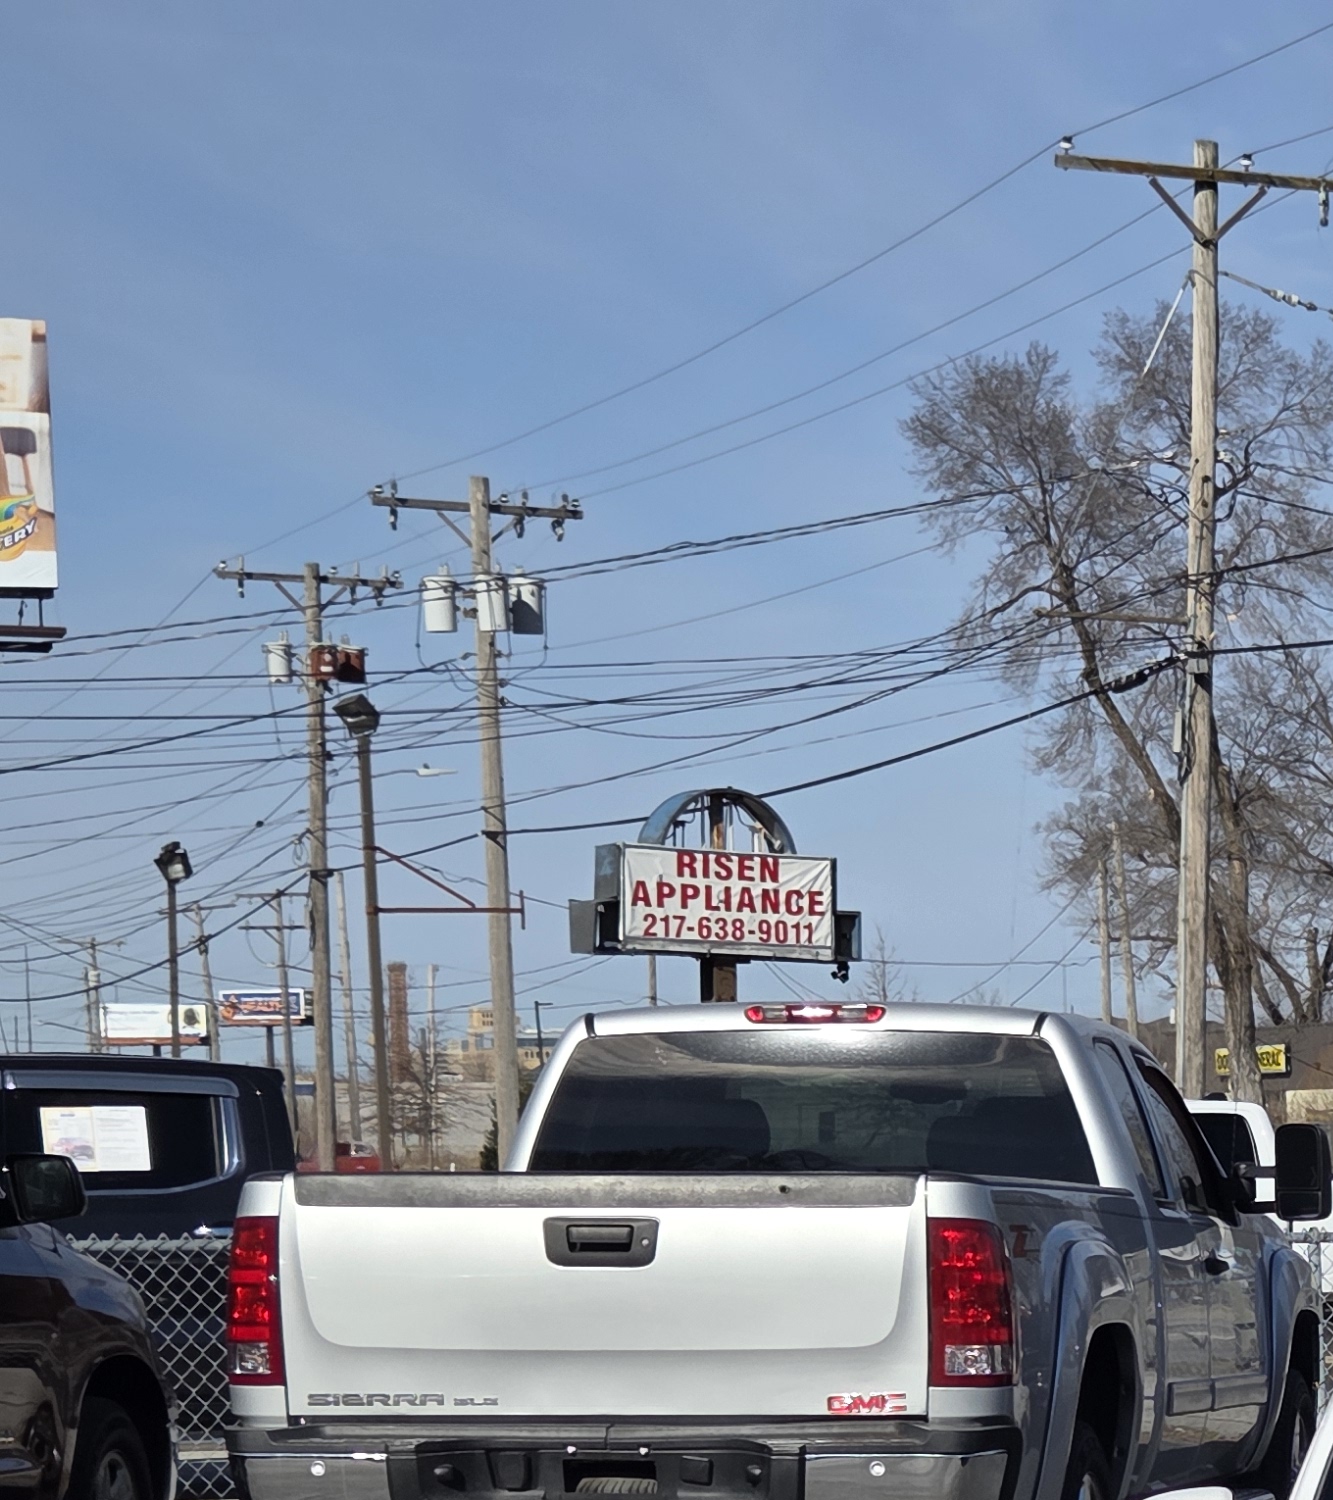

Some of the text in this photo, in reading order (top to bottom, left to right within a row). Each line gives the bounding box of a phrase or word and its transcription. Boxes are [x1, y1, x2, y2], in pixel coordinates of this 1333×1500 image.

[676, 851, 780, 884] RISEN
[630, 880, 826, 917] APPLIANCE
[642, 913, 815, 945] 217-638-9011
[826, 1392, 908, 1414] GMC
